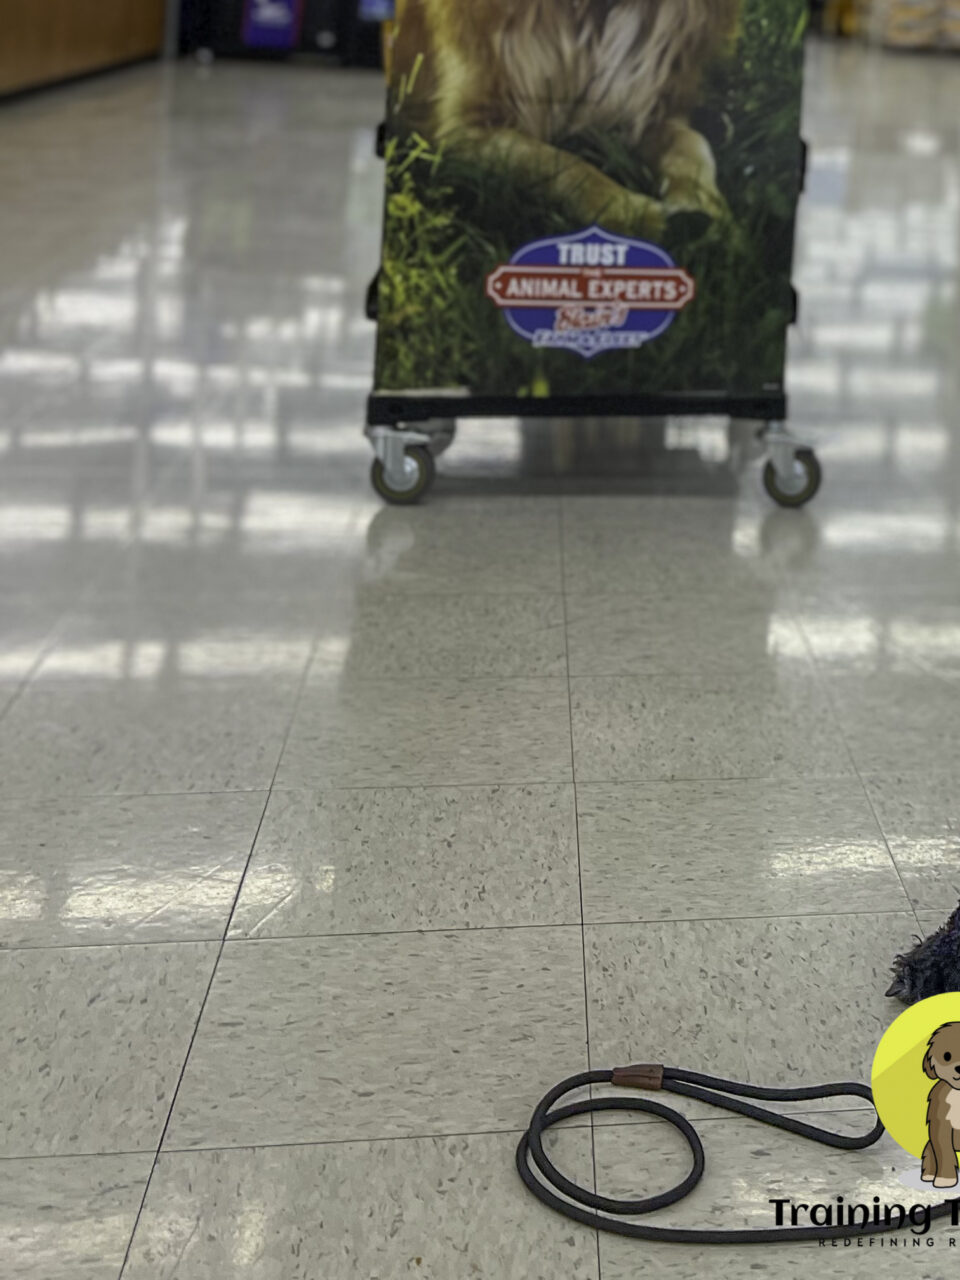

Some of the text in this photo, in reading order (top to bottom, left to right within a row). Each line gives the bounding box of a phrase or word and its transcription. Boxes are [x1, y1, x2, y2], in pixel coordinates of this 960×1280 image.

[557, 243, 629, 265] TRUST
[506, 277, 677, 301] ANIMAL EXPERTS
